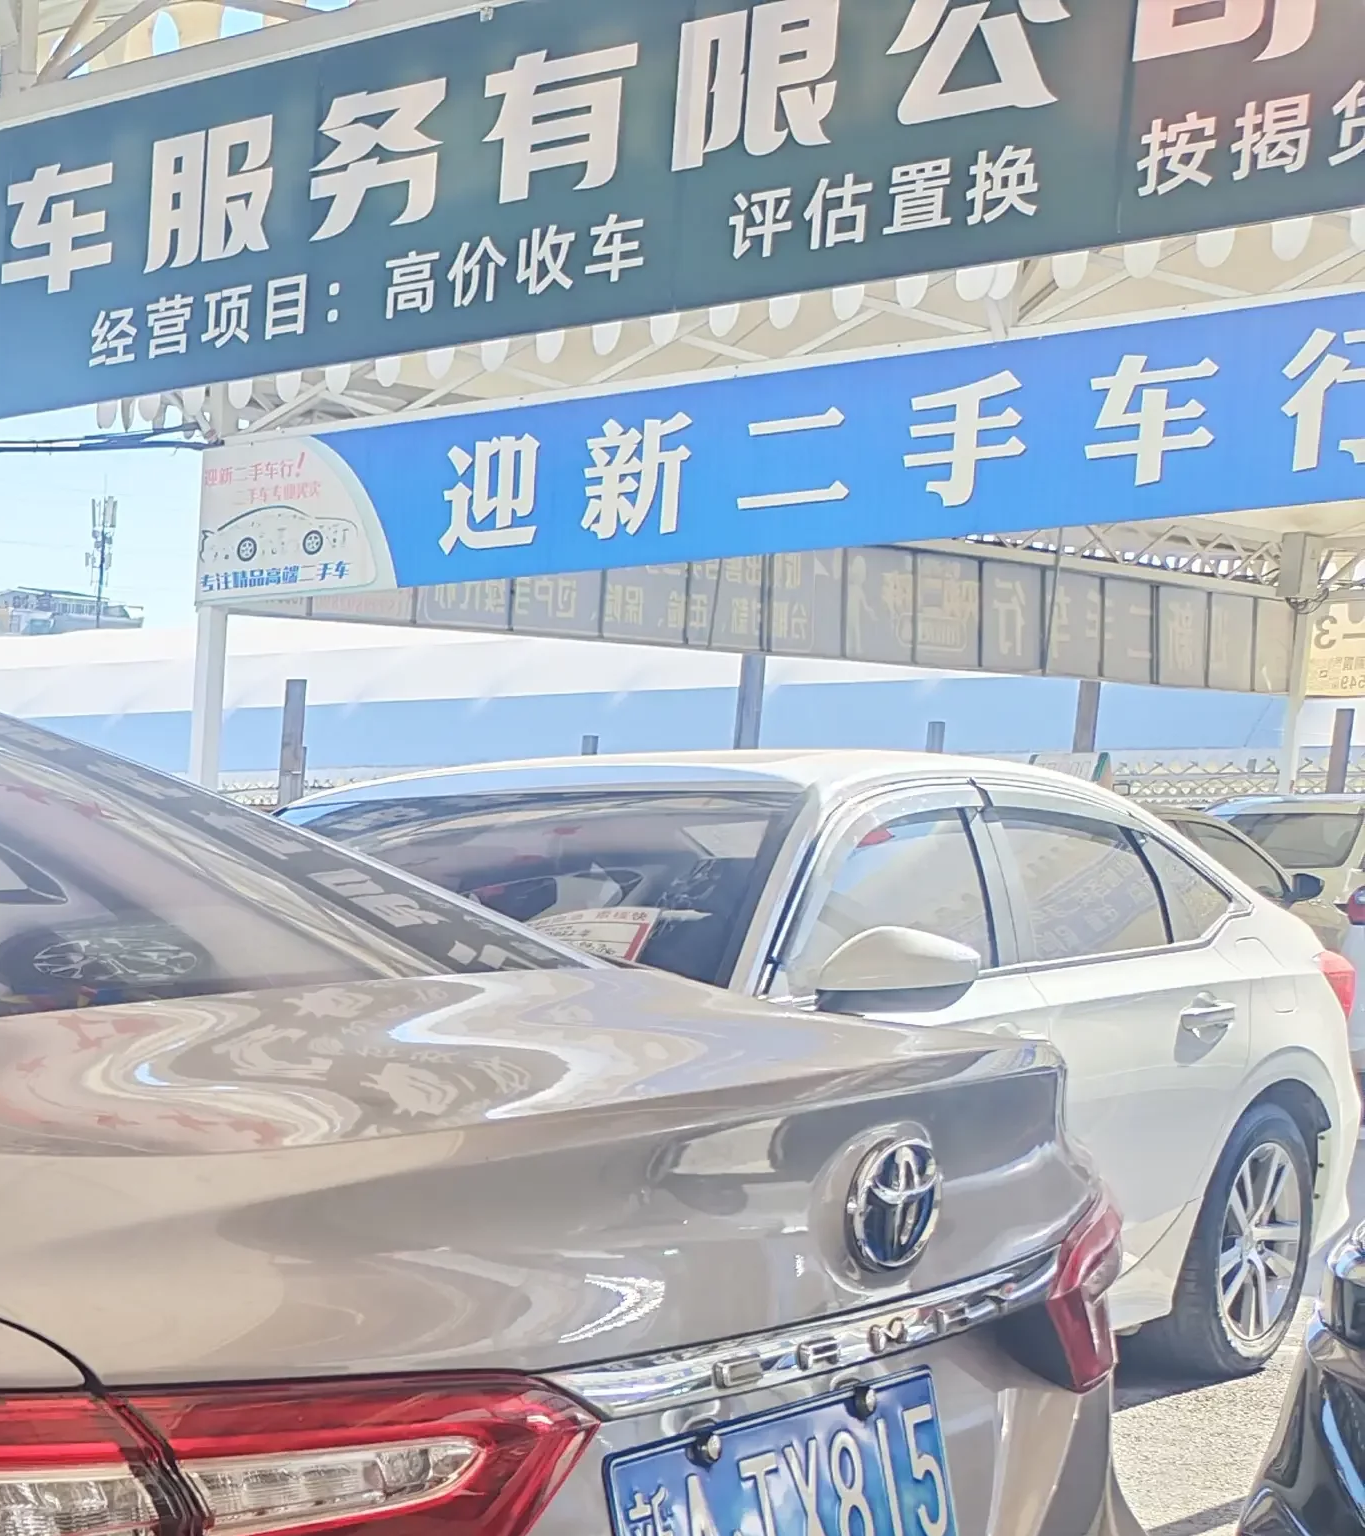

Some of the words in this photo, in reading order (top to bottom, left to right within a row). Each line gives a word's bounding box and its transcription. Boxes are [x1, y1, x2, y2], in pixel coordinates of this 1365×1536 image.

[729, 145, 1039, 261] 评估置换
[439, 330, 1365, 555] 迎新二手车行
[200, 560, 352, 592] 专注精品高端二手车
